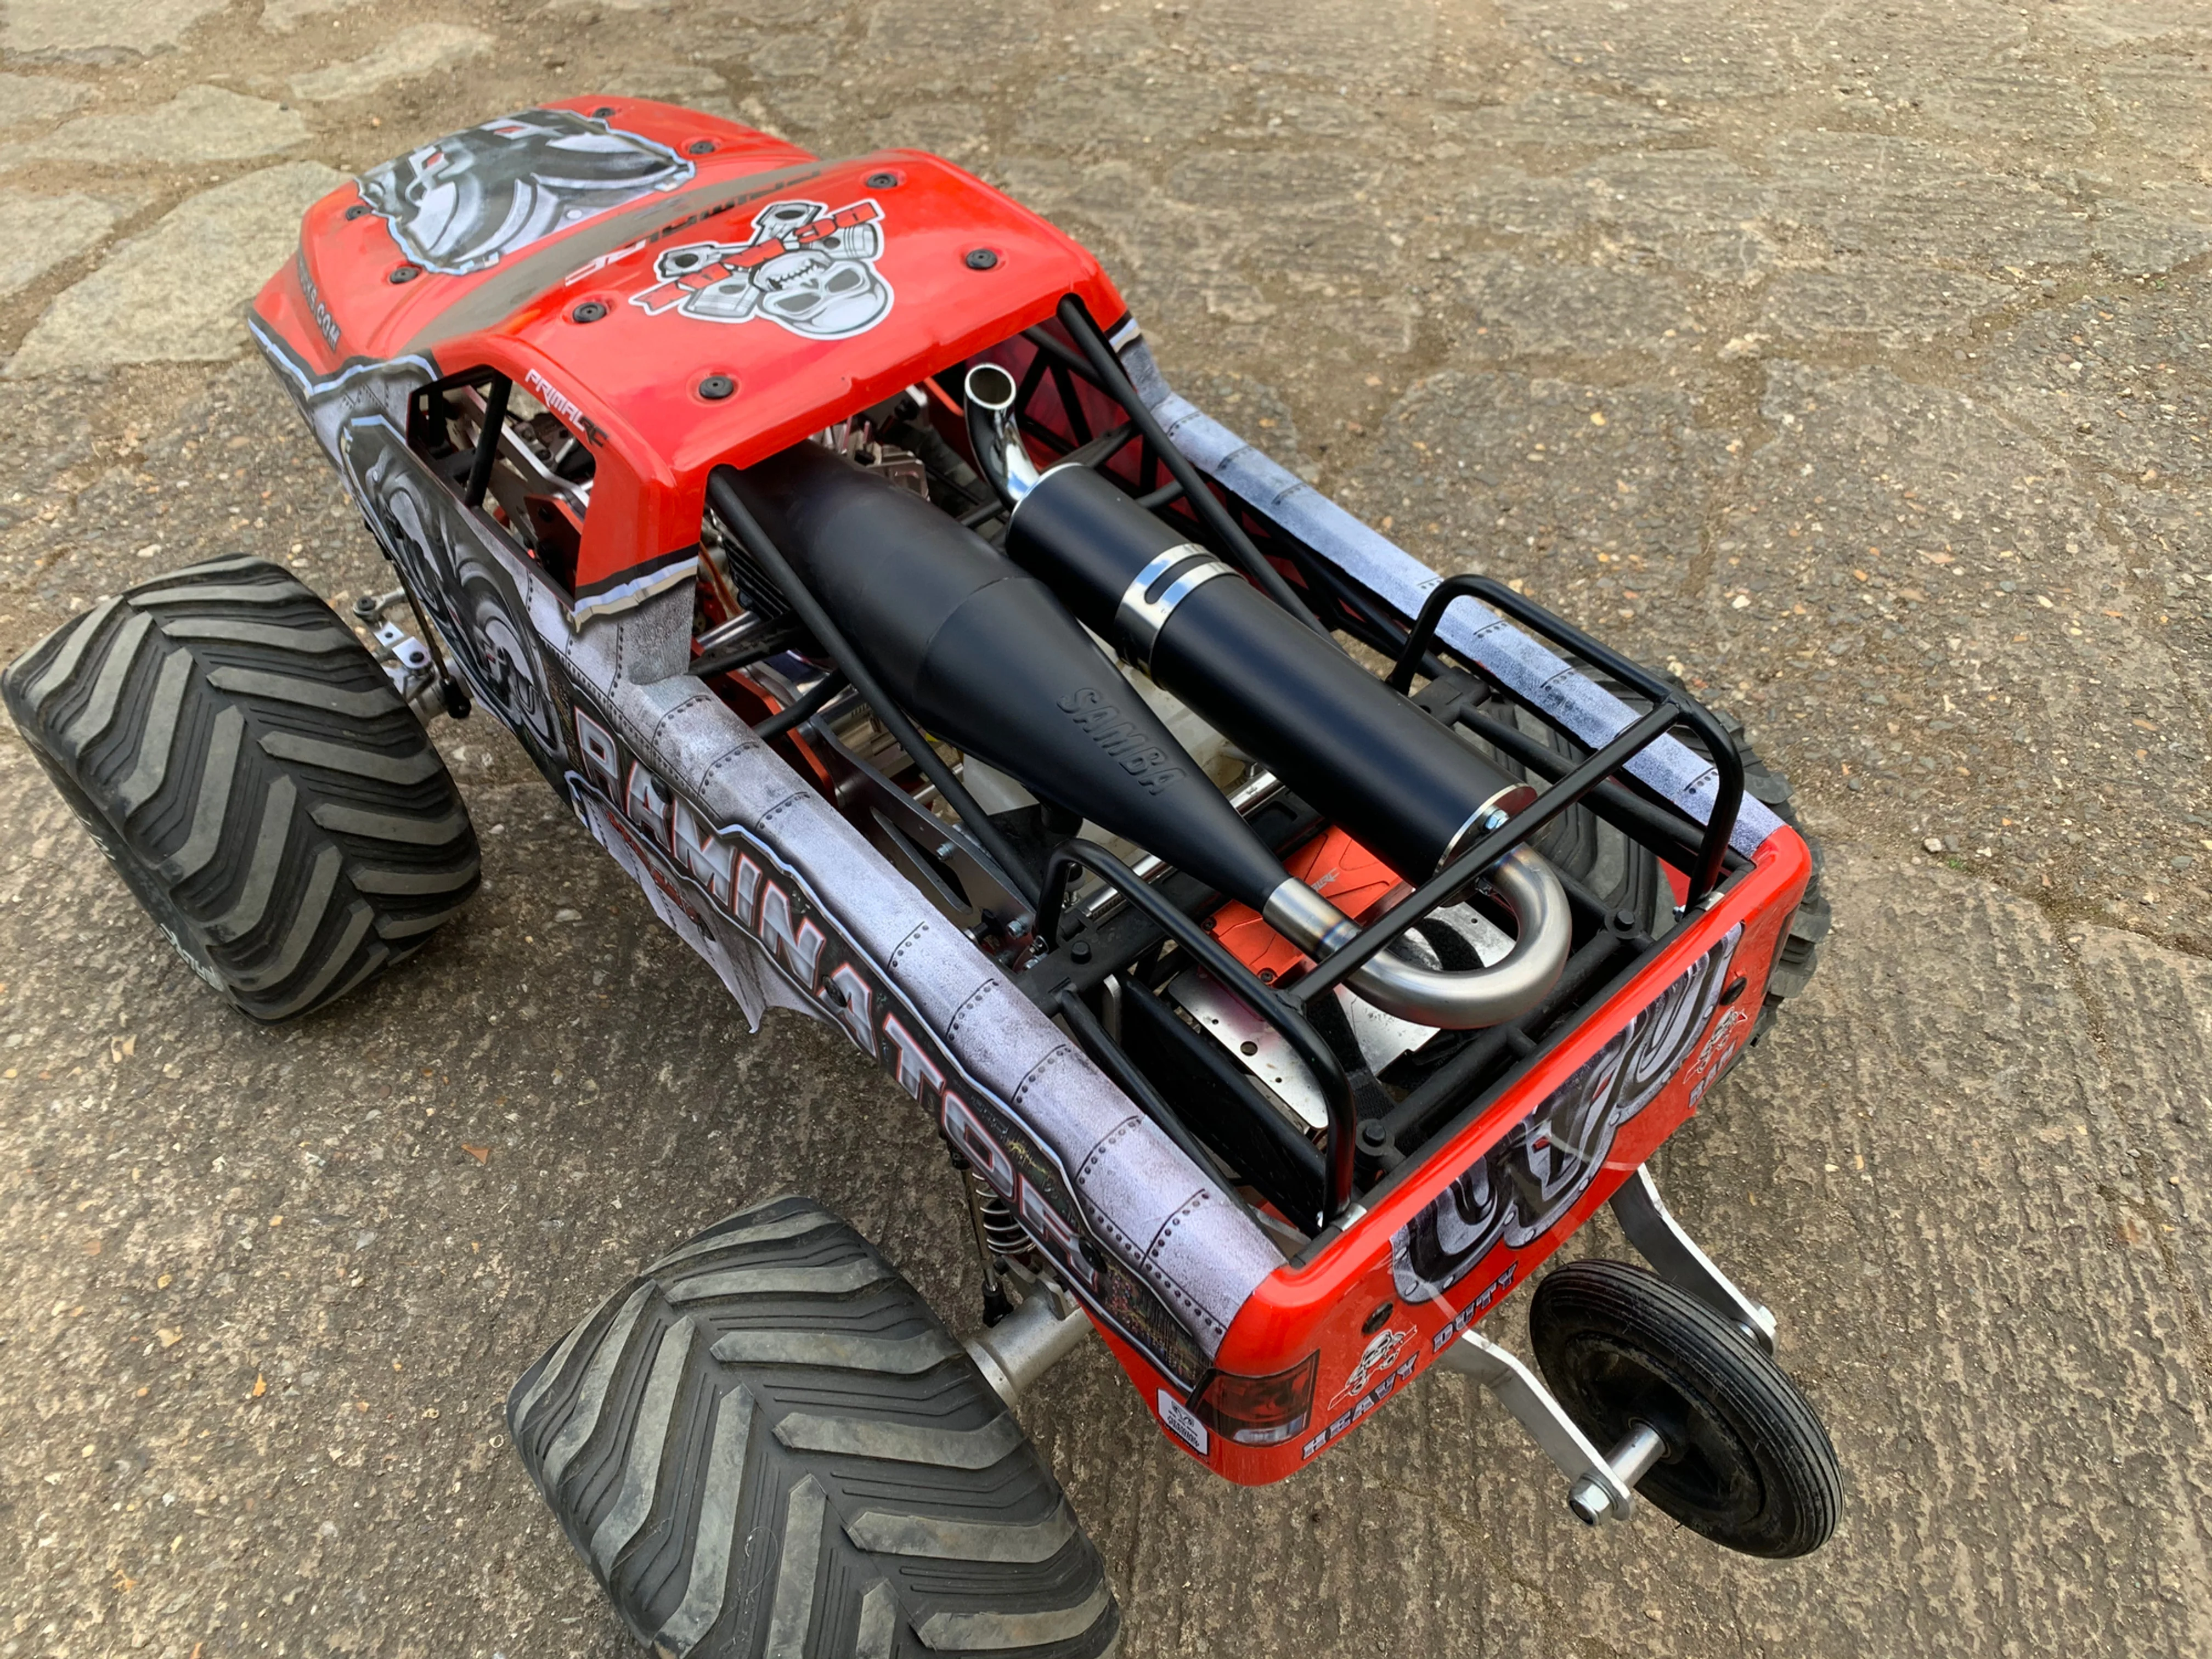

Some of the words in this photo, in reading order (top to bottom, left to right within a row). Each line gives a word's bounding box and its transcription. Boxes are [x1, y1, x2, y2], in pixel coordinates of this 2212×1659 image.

[1056, 687, 1188, 795] SAMBA
[574, 706, 1098, 1291] RAMINATOR
[1302, 1351, 1419, 1460] HEAVY
[1432, 1261, 1519, 1353] DUTY
